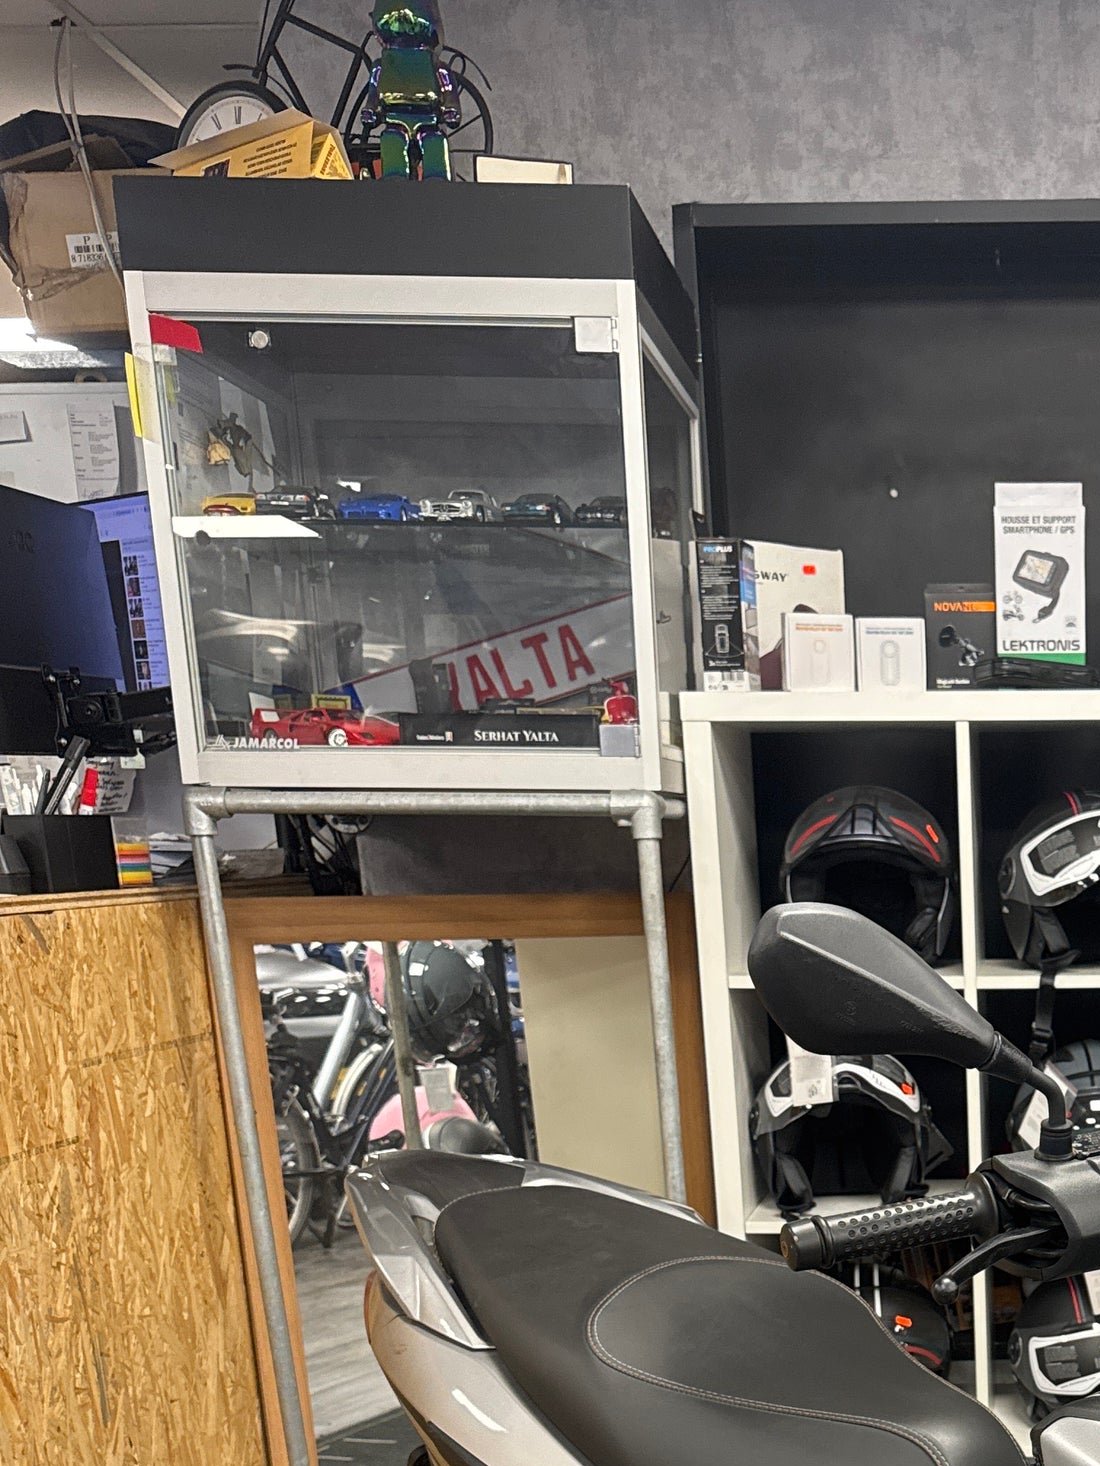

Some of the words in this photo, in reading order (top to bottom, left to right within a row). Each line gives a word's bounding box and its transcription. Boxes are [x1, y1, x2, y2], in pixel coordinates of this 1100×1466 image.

[1001, 516, 1030, 524] HOUSSE
[1032, 516, 1041, 524] ET
[1043, 515, 1076, 524] SUPPORT
[1003, 526, 1053, 534] SMARTPHONE
[1060, 526, 1075, 534] GPS
[1002, 639, 1081, 651] LEKTRONIS
[474, 730, 521, 742] SERHAT
[522, 730, 559, 742] YALTA
[233, 737, 300, 749] JAMARCOL
